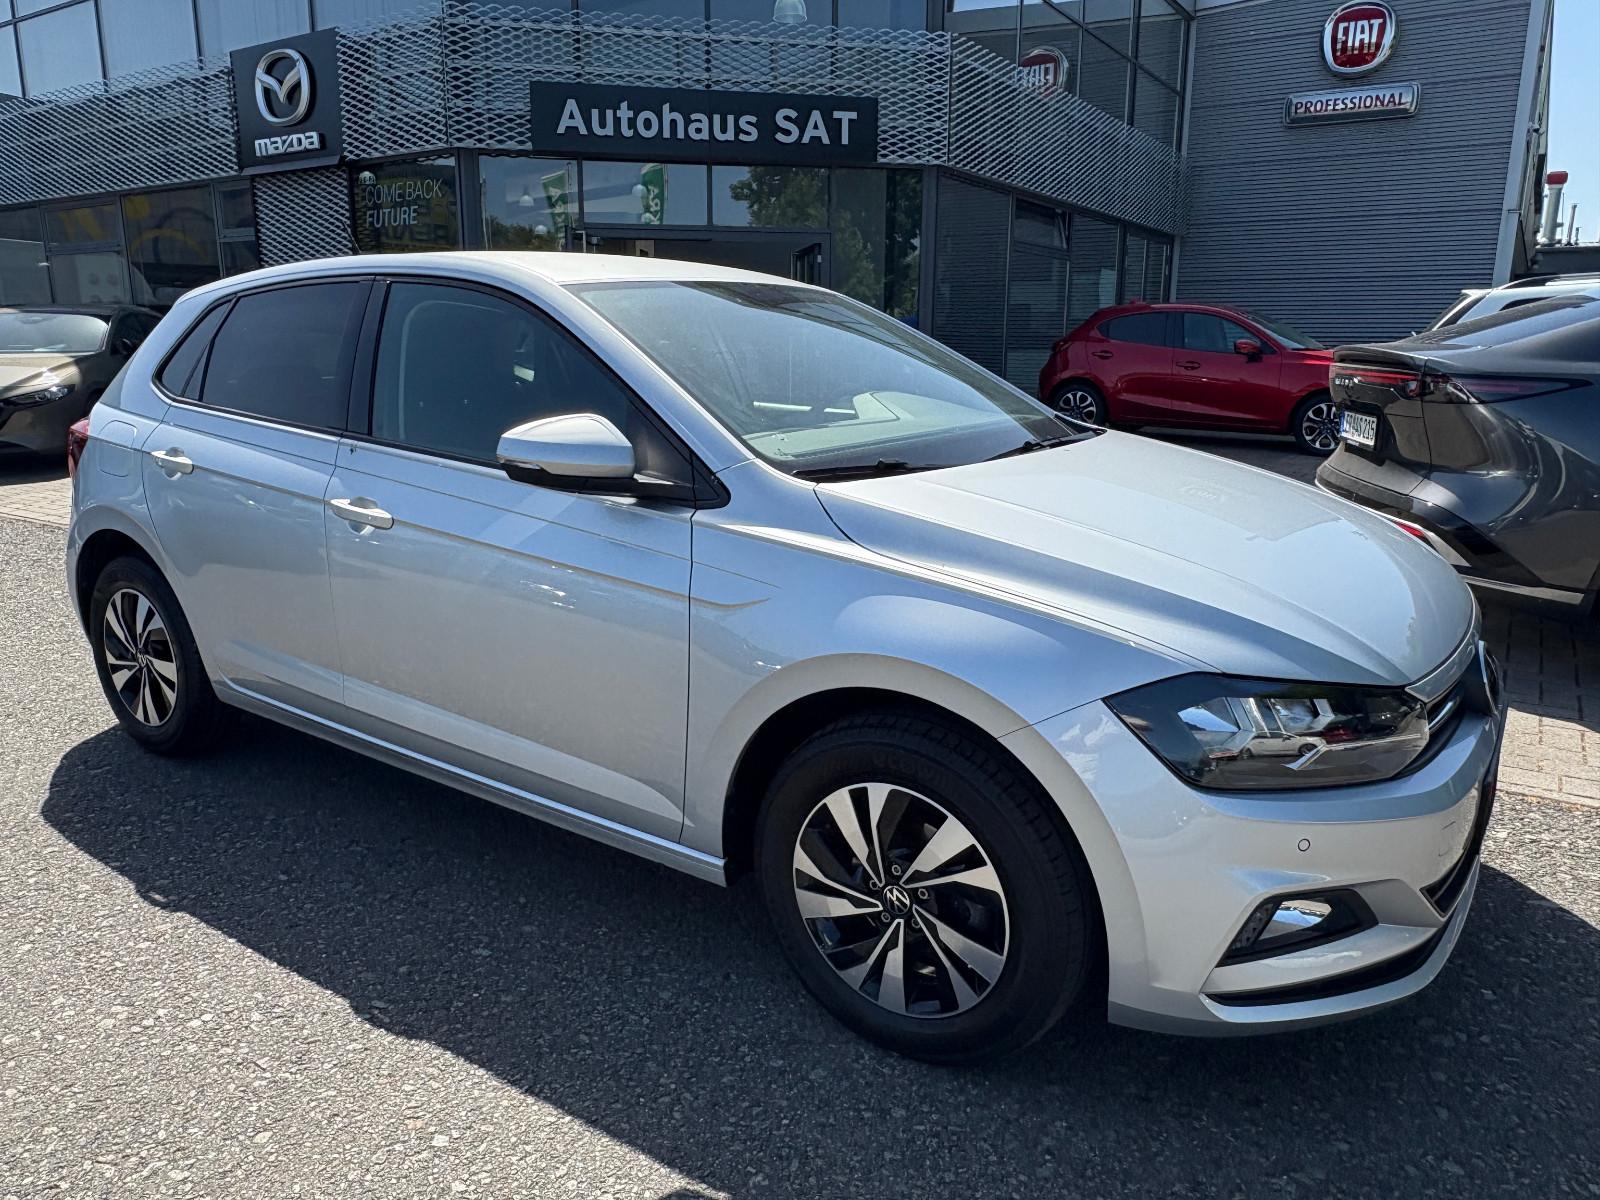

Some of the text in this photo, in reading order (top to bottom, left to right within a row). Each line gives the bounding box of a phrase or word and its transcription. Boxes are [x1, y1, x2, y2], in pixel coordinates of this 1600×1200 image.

[1336, 18, 1384, 56] FIAT
[1294, 92, 1408, 115] PROFESSIONAL
[556, 98, 858, 145] Autohaus SAT
[365, 179, 443, 207] COME BACK
[366, 205, 419, 228] FUTURE
